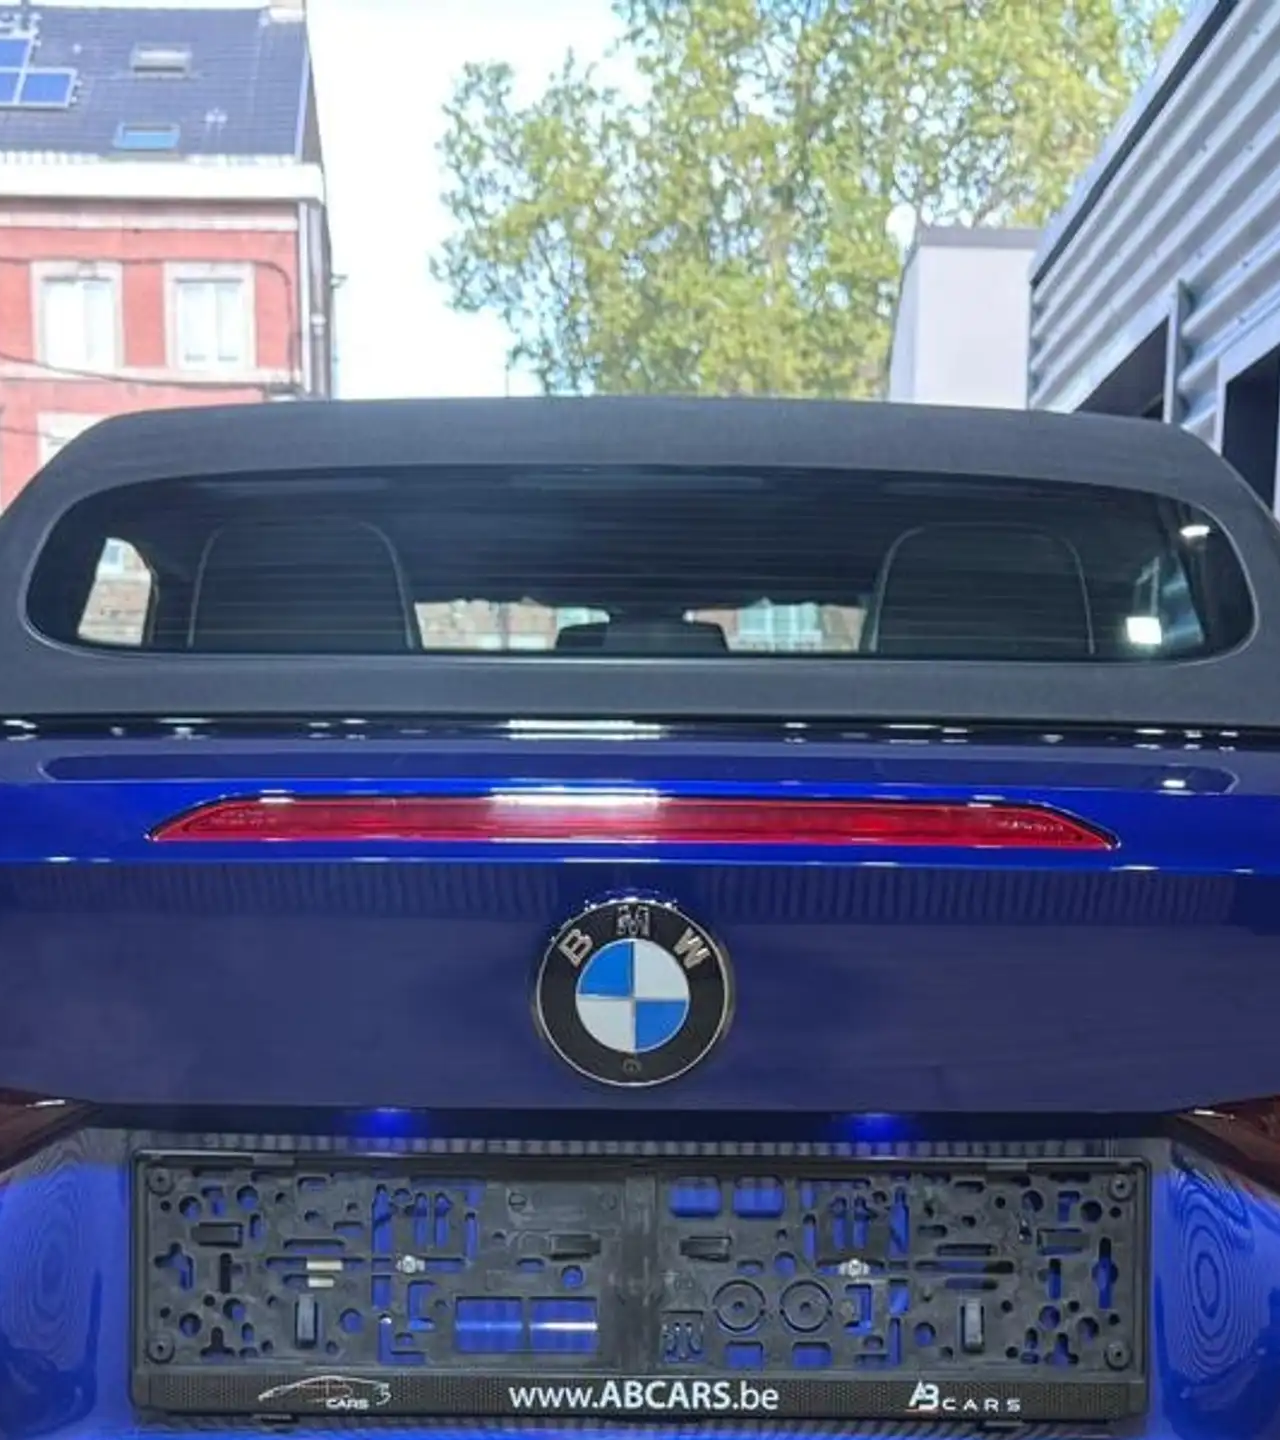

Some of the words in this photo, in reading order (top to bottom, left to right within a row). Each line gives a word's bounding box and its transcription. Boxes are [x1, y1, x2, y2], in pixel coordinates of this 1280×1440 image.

[557, 902, 712, 970] BMW
[325, 1398, 370, 1411] CARS
[508, 1379, 780, 1410] www.ABCARS.be
